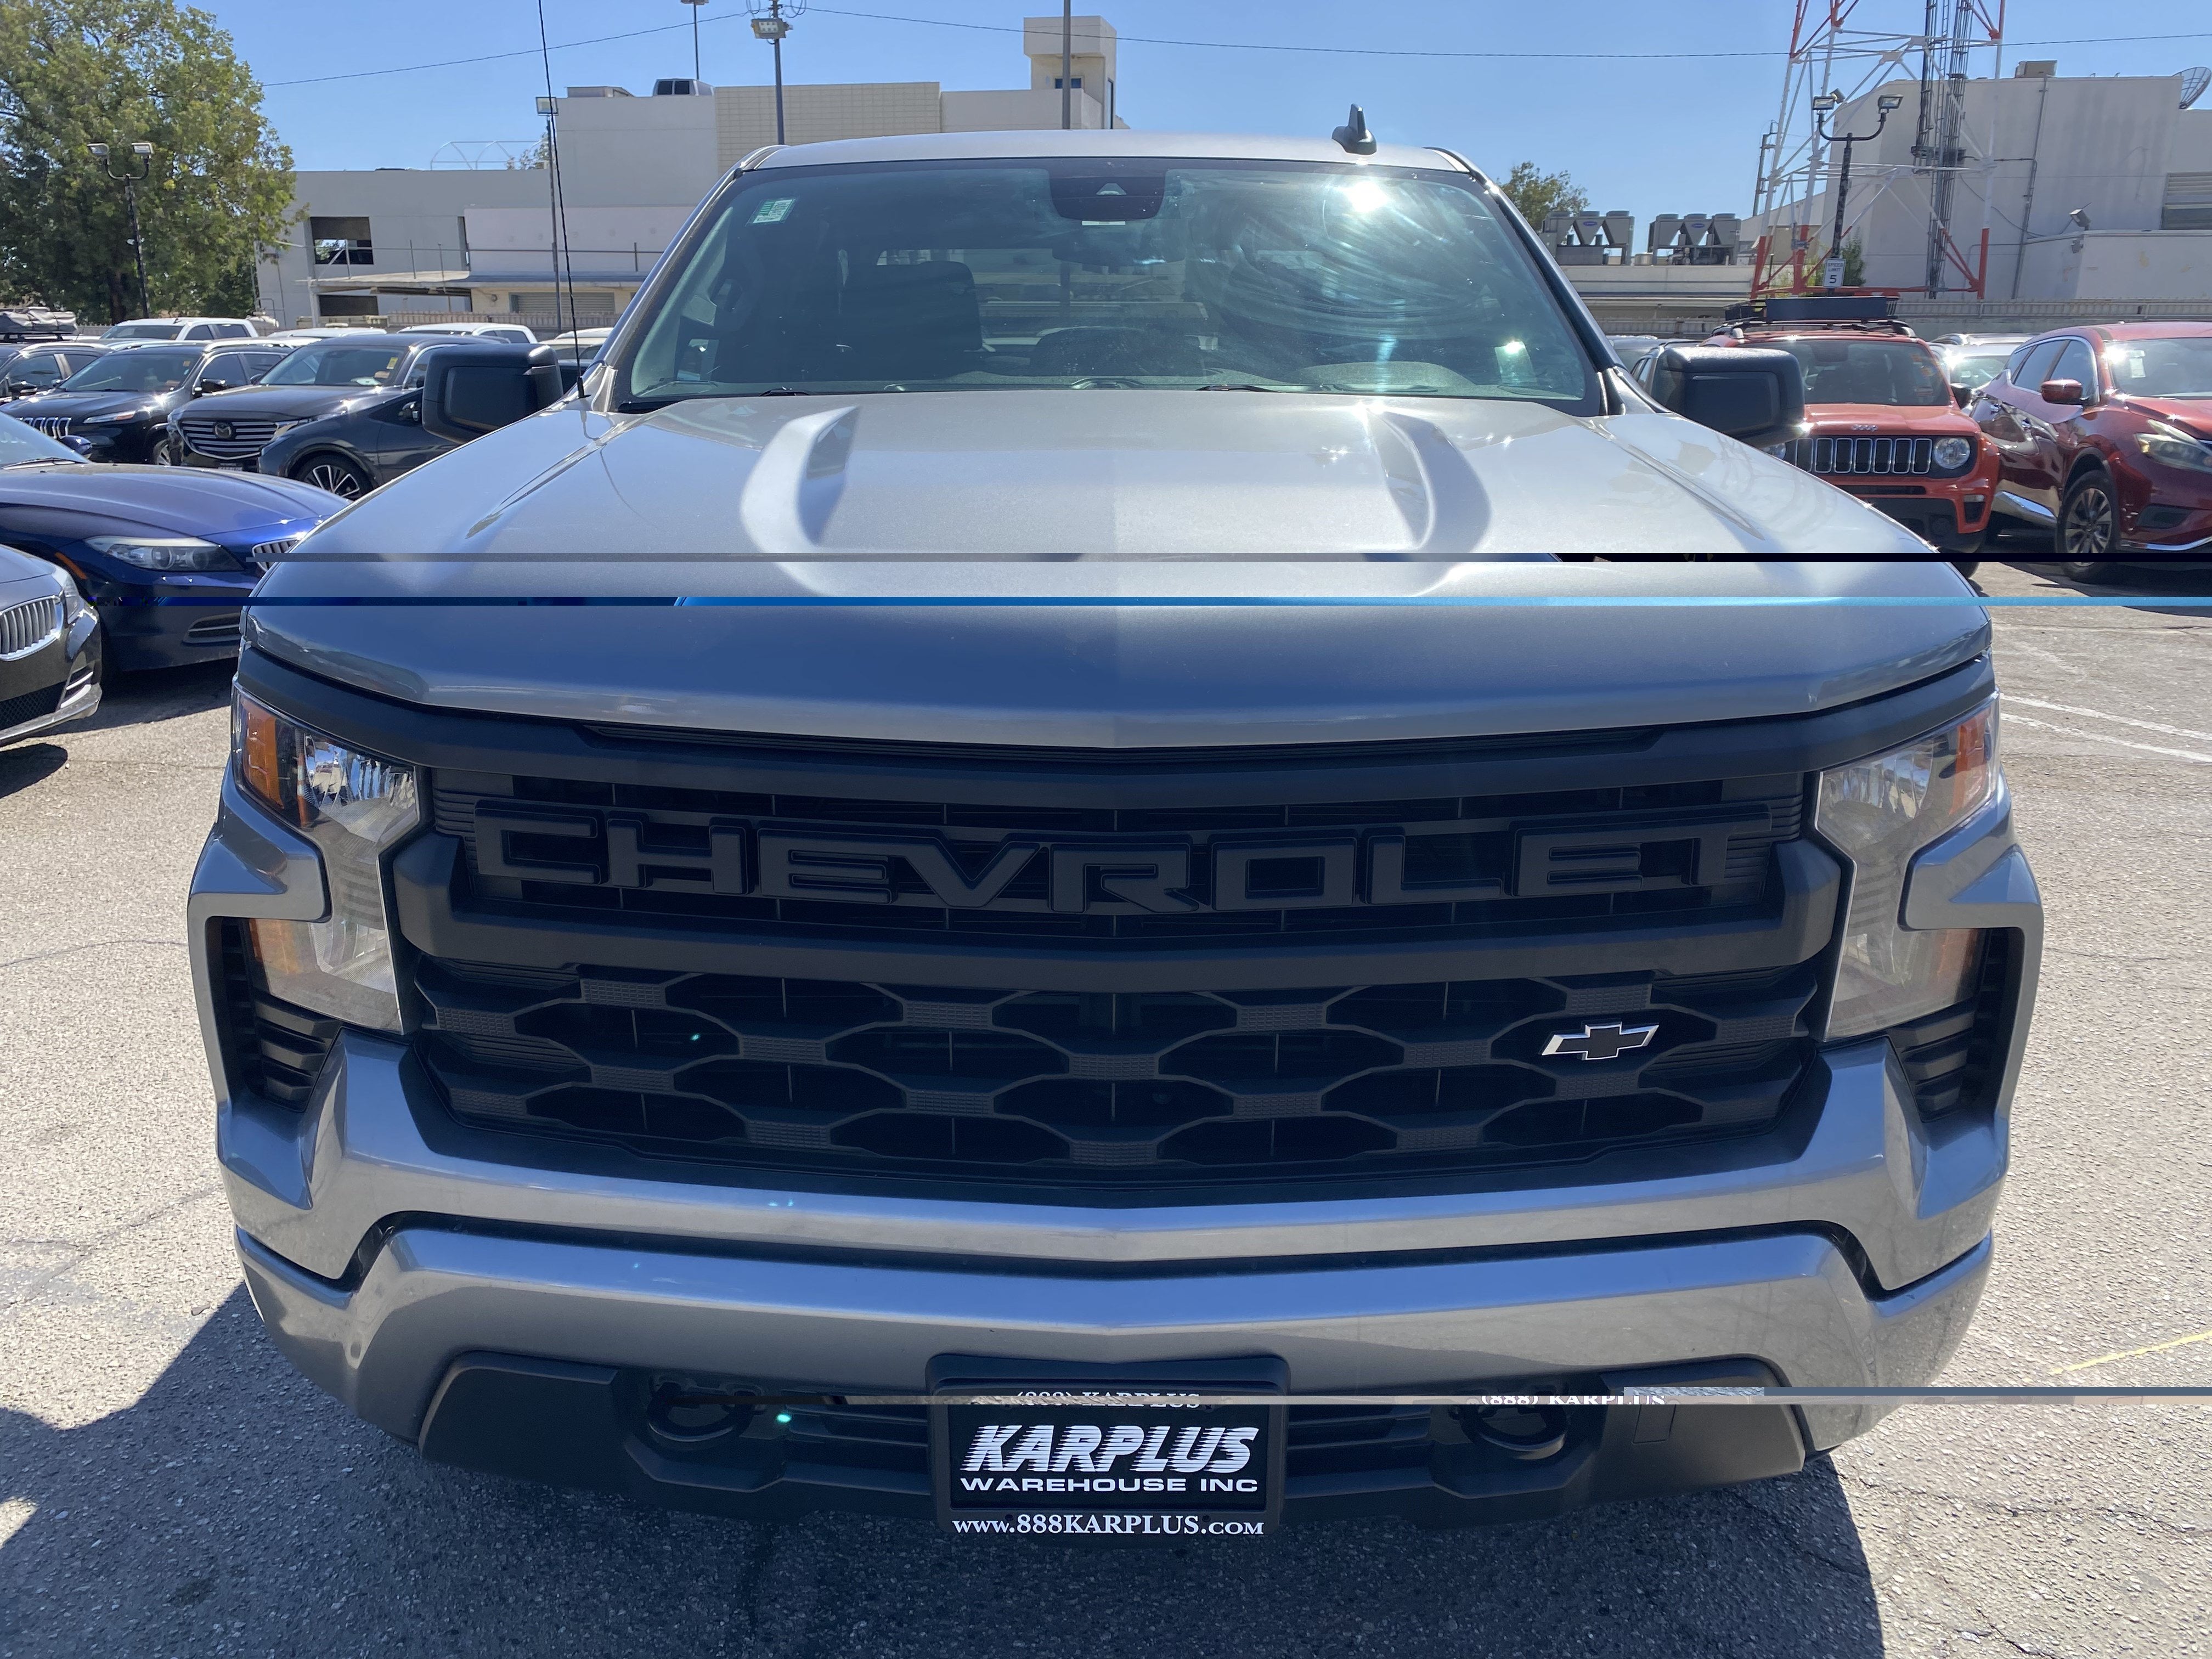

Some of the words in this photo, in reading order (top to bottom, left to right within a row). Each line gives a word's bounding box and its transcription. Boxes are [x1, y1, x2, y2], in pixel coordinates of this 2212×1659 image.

[1829, 275, 1837, 284] 5
[474, 800, 1772, 913] CHEVROLET
[960, 1425, 1259, 1474] KARPLUS
[960, 1478, 1187, 1492] WAREHOUSE
[1200, 1478, 1258, 1493] INC
